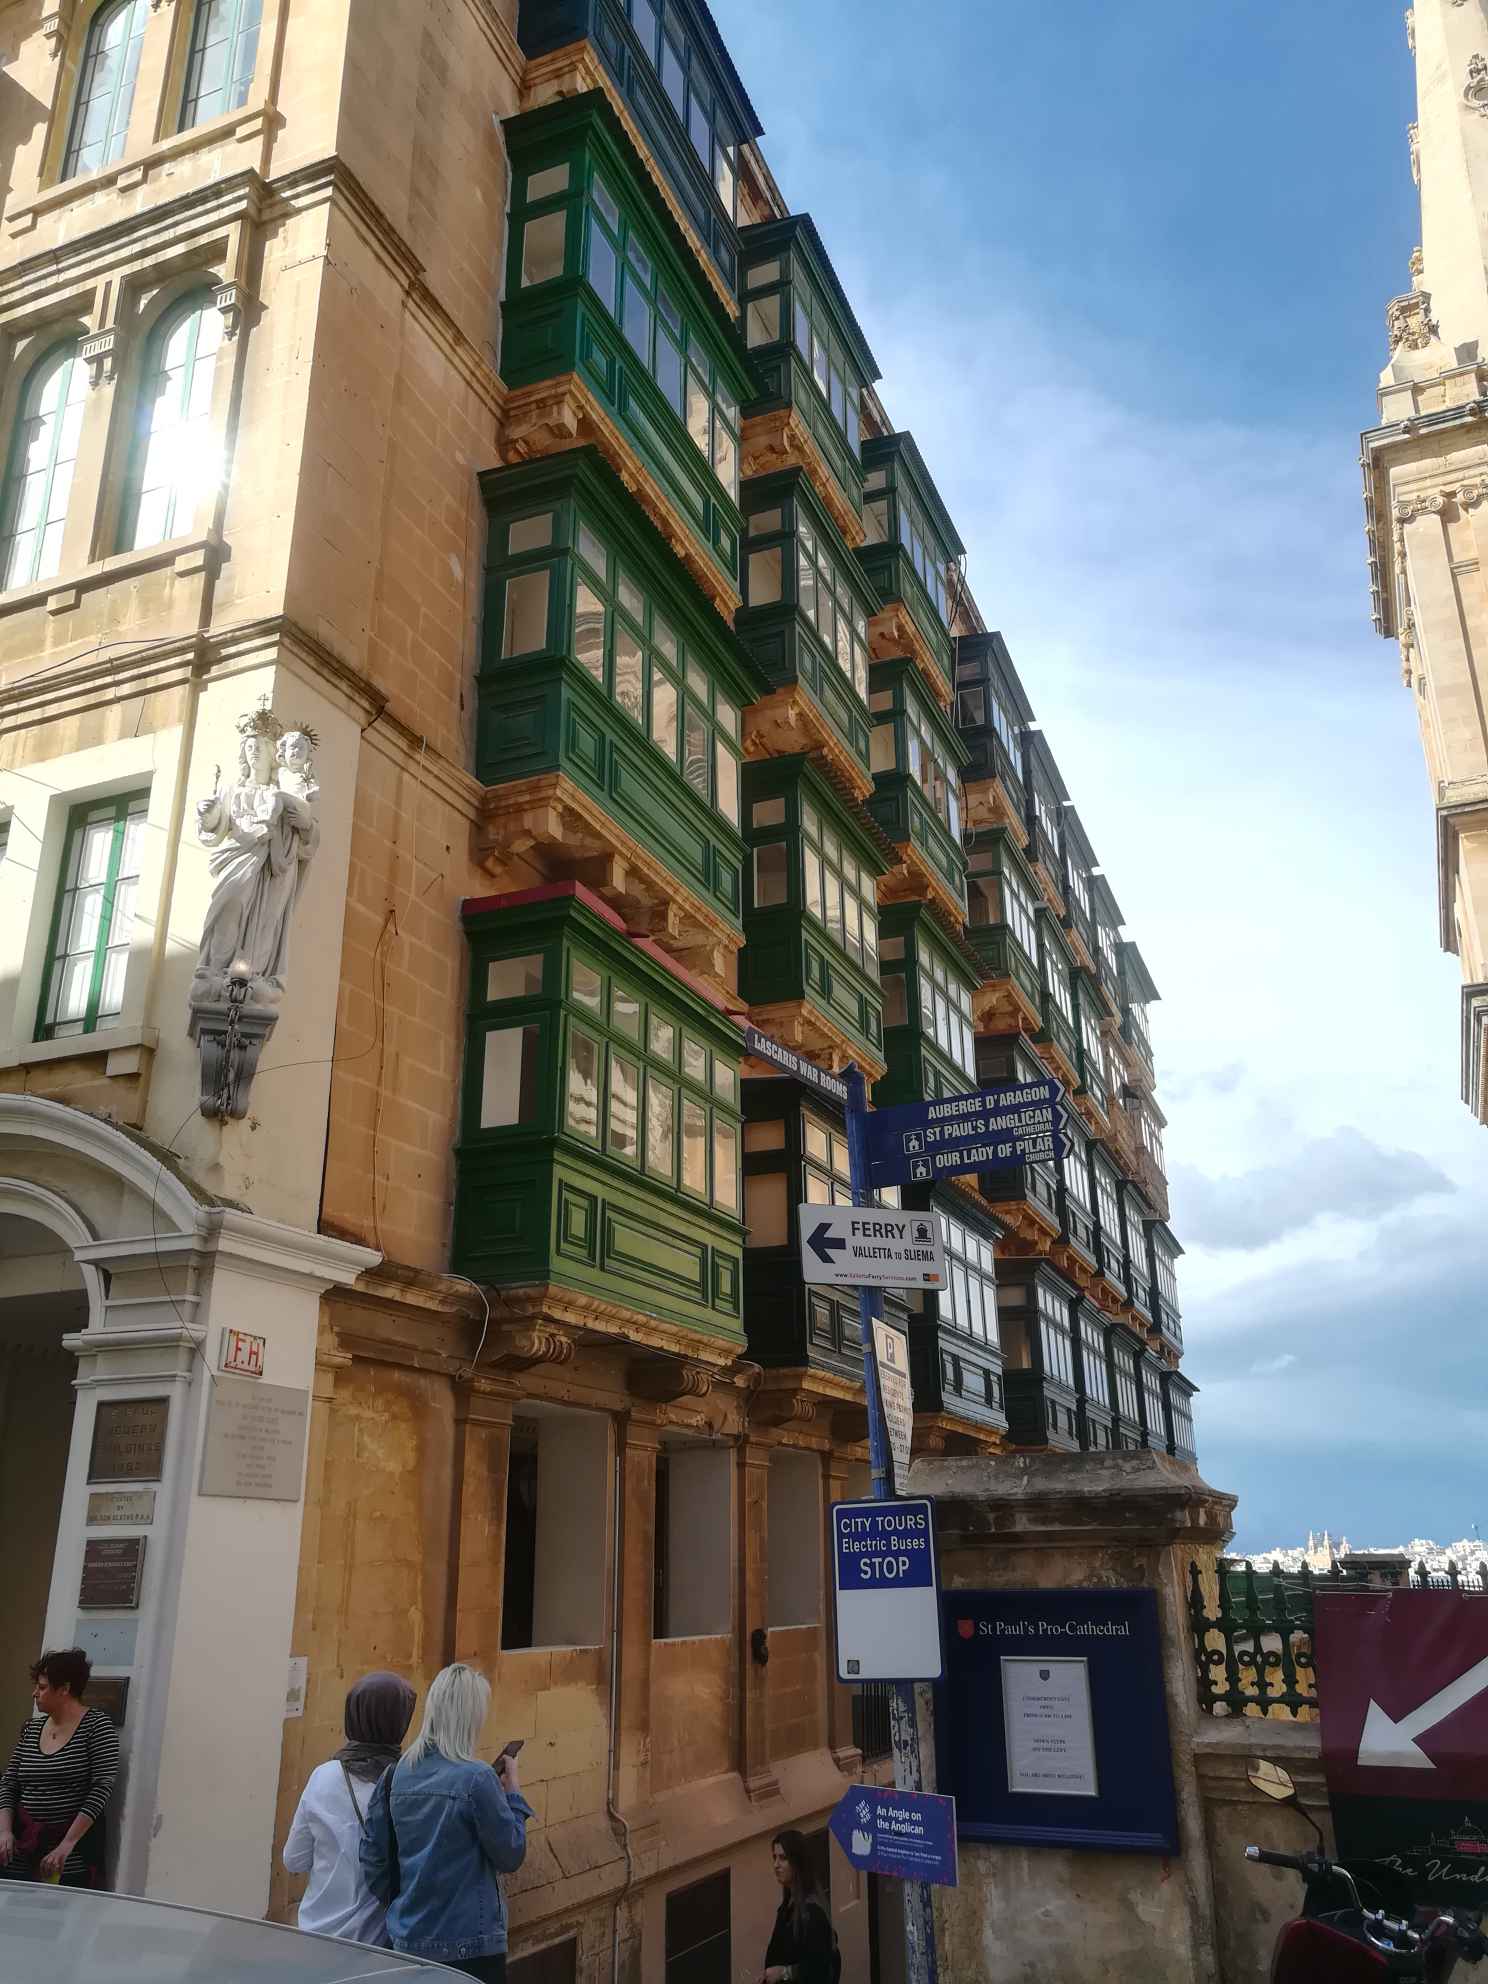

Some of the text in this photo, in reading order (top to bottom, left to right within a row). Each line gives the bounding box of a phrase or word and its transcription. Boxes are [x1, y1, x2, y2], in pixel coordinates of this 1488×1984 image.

[754, 1034, 848, 1099] LASCARIS WAR ROOMS
[928, 1098, 983, 1120] AUBERGE
[926, 1108, 1053, 1142] ST PAUL'S ANGLICAN
[1013, 1122, 1054, 1136] CATHEDRAL
[936, 1136, 1053, 1168] OUR LADY OF PILAR
[1025, 1150, 1055, 1162] CHURCH
[851, 1221, 906, 1240] FERRY
[852, 1246, 935, 1262] VALLETTA TO SLIEMA
[841, 1514, 926, 1533] CITY TOURS
[842, 1536, 926, 1552] Electric Buses
[860, 1556, 910, 1579] STOP
[979, 1621, 1130, 1636] St Paul's Pro-Cathedral
[876, 1805, 887, 1816] An
[888, 1806, 910, 1821] Angle
[911, 1811, 922, 1821] on
[877, 1818, 924, 1836] the Anglican
[1425, 1859, 1488, 1883] Und
